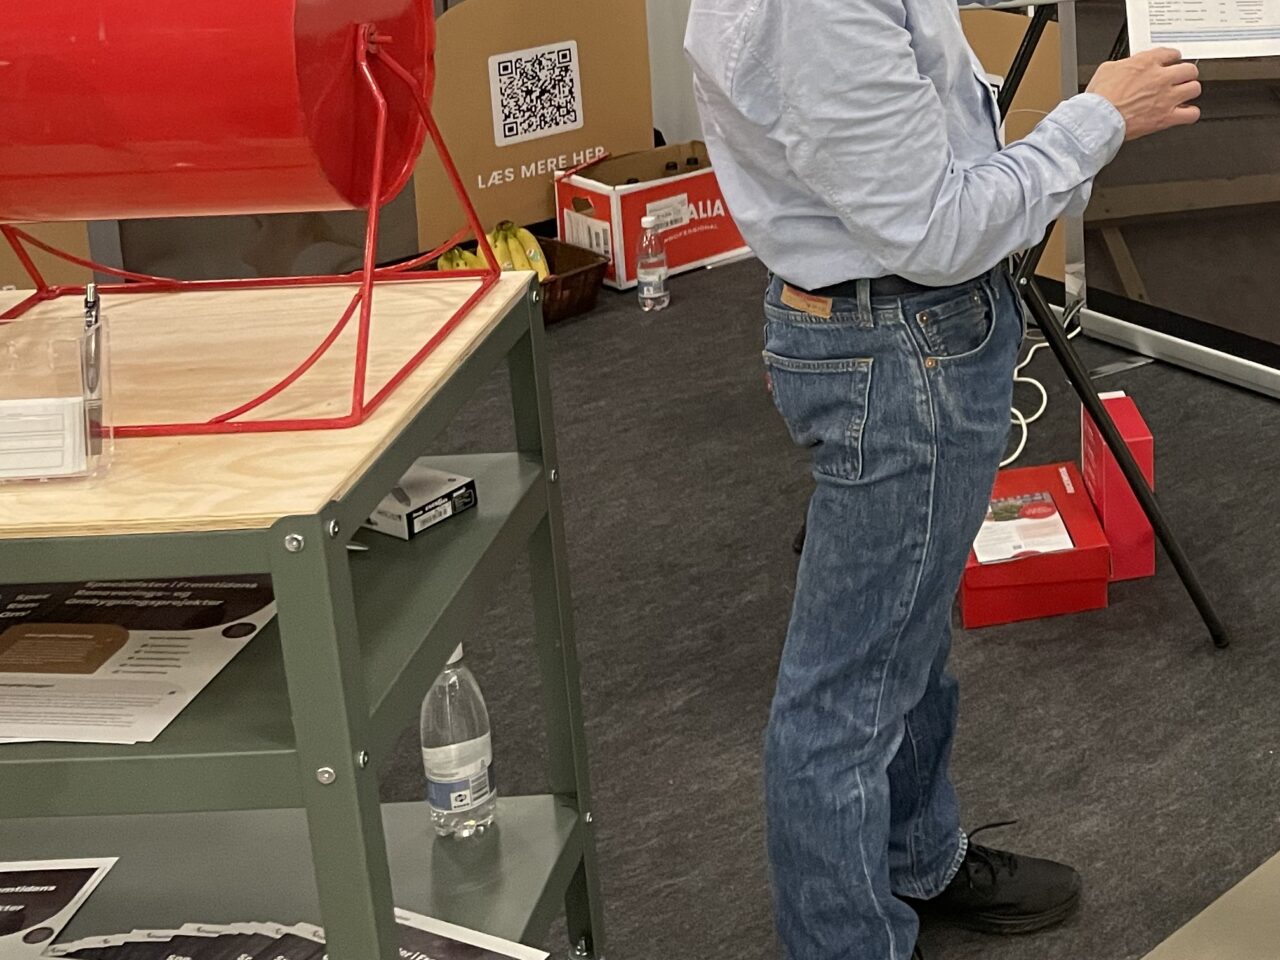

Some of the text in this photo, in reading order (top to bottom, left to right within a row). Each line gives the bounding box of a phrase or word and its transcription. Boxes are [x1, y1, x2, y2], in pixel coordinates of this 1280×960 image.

[477, 167, 515, 189] LÆS
[521, 155, 567, 179] MERE
[687, 199, 725, 220] ALIA
